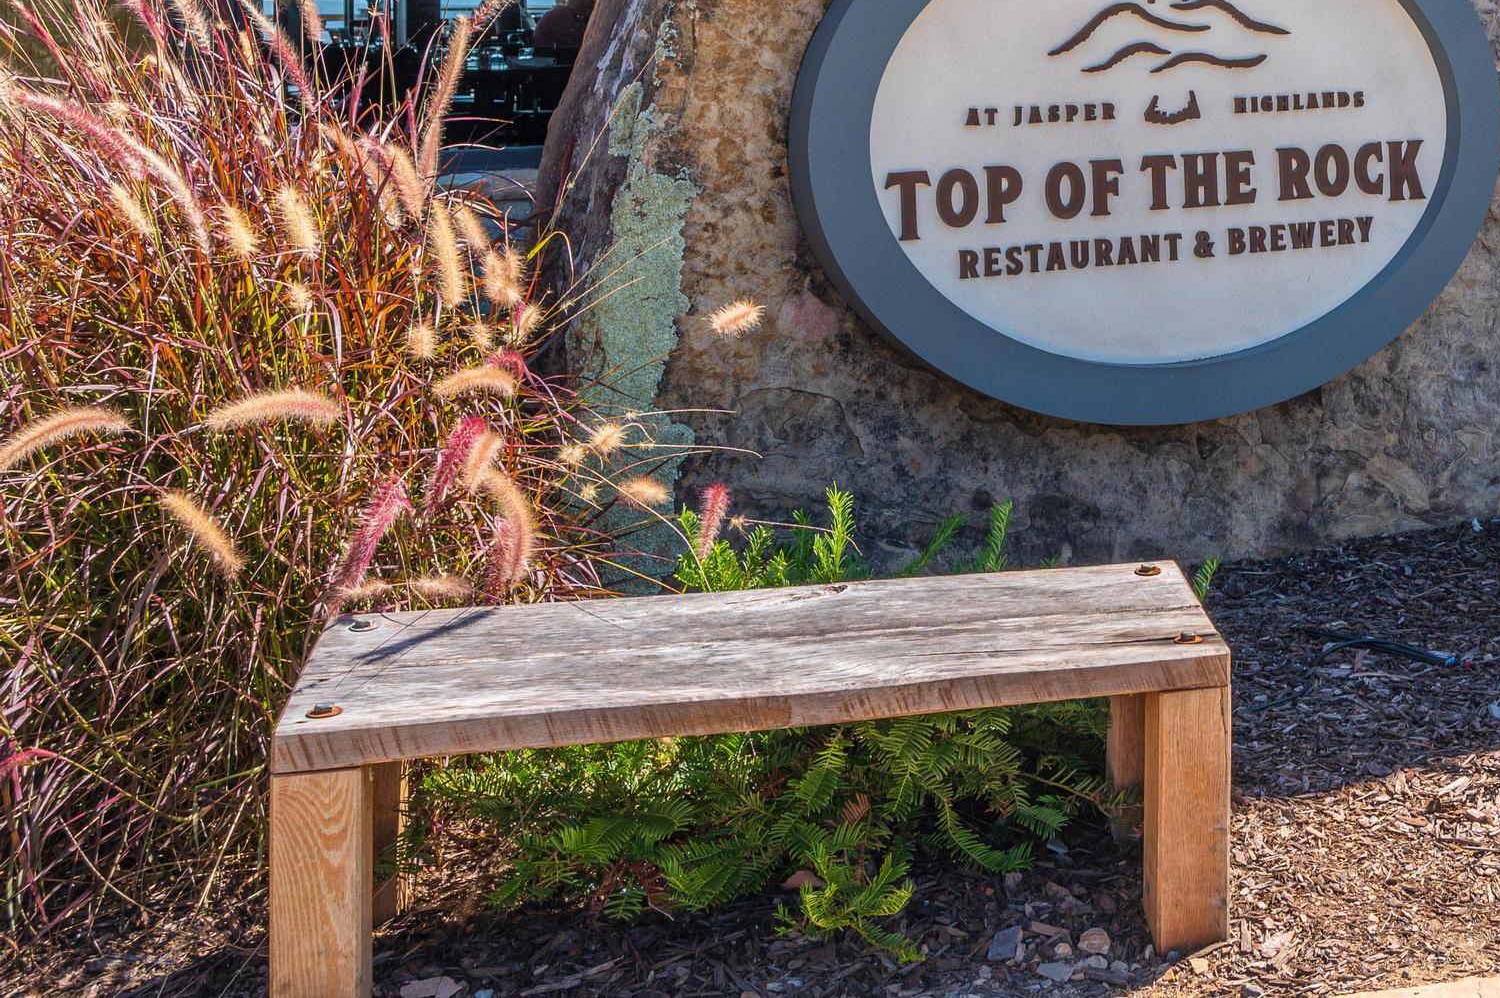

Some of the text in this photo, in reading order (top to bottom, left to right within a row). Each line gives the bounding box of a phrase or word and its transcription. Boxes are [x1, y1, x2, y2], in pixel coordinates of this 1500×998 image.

[964, 90, 1366, 127] AT JASPER HIGHLANDS
[883, 139, 1428, 242] TOP OF THE ROCK
[958, 215, 1376, 280] RESTAURANT & BREWERY
